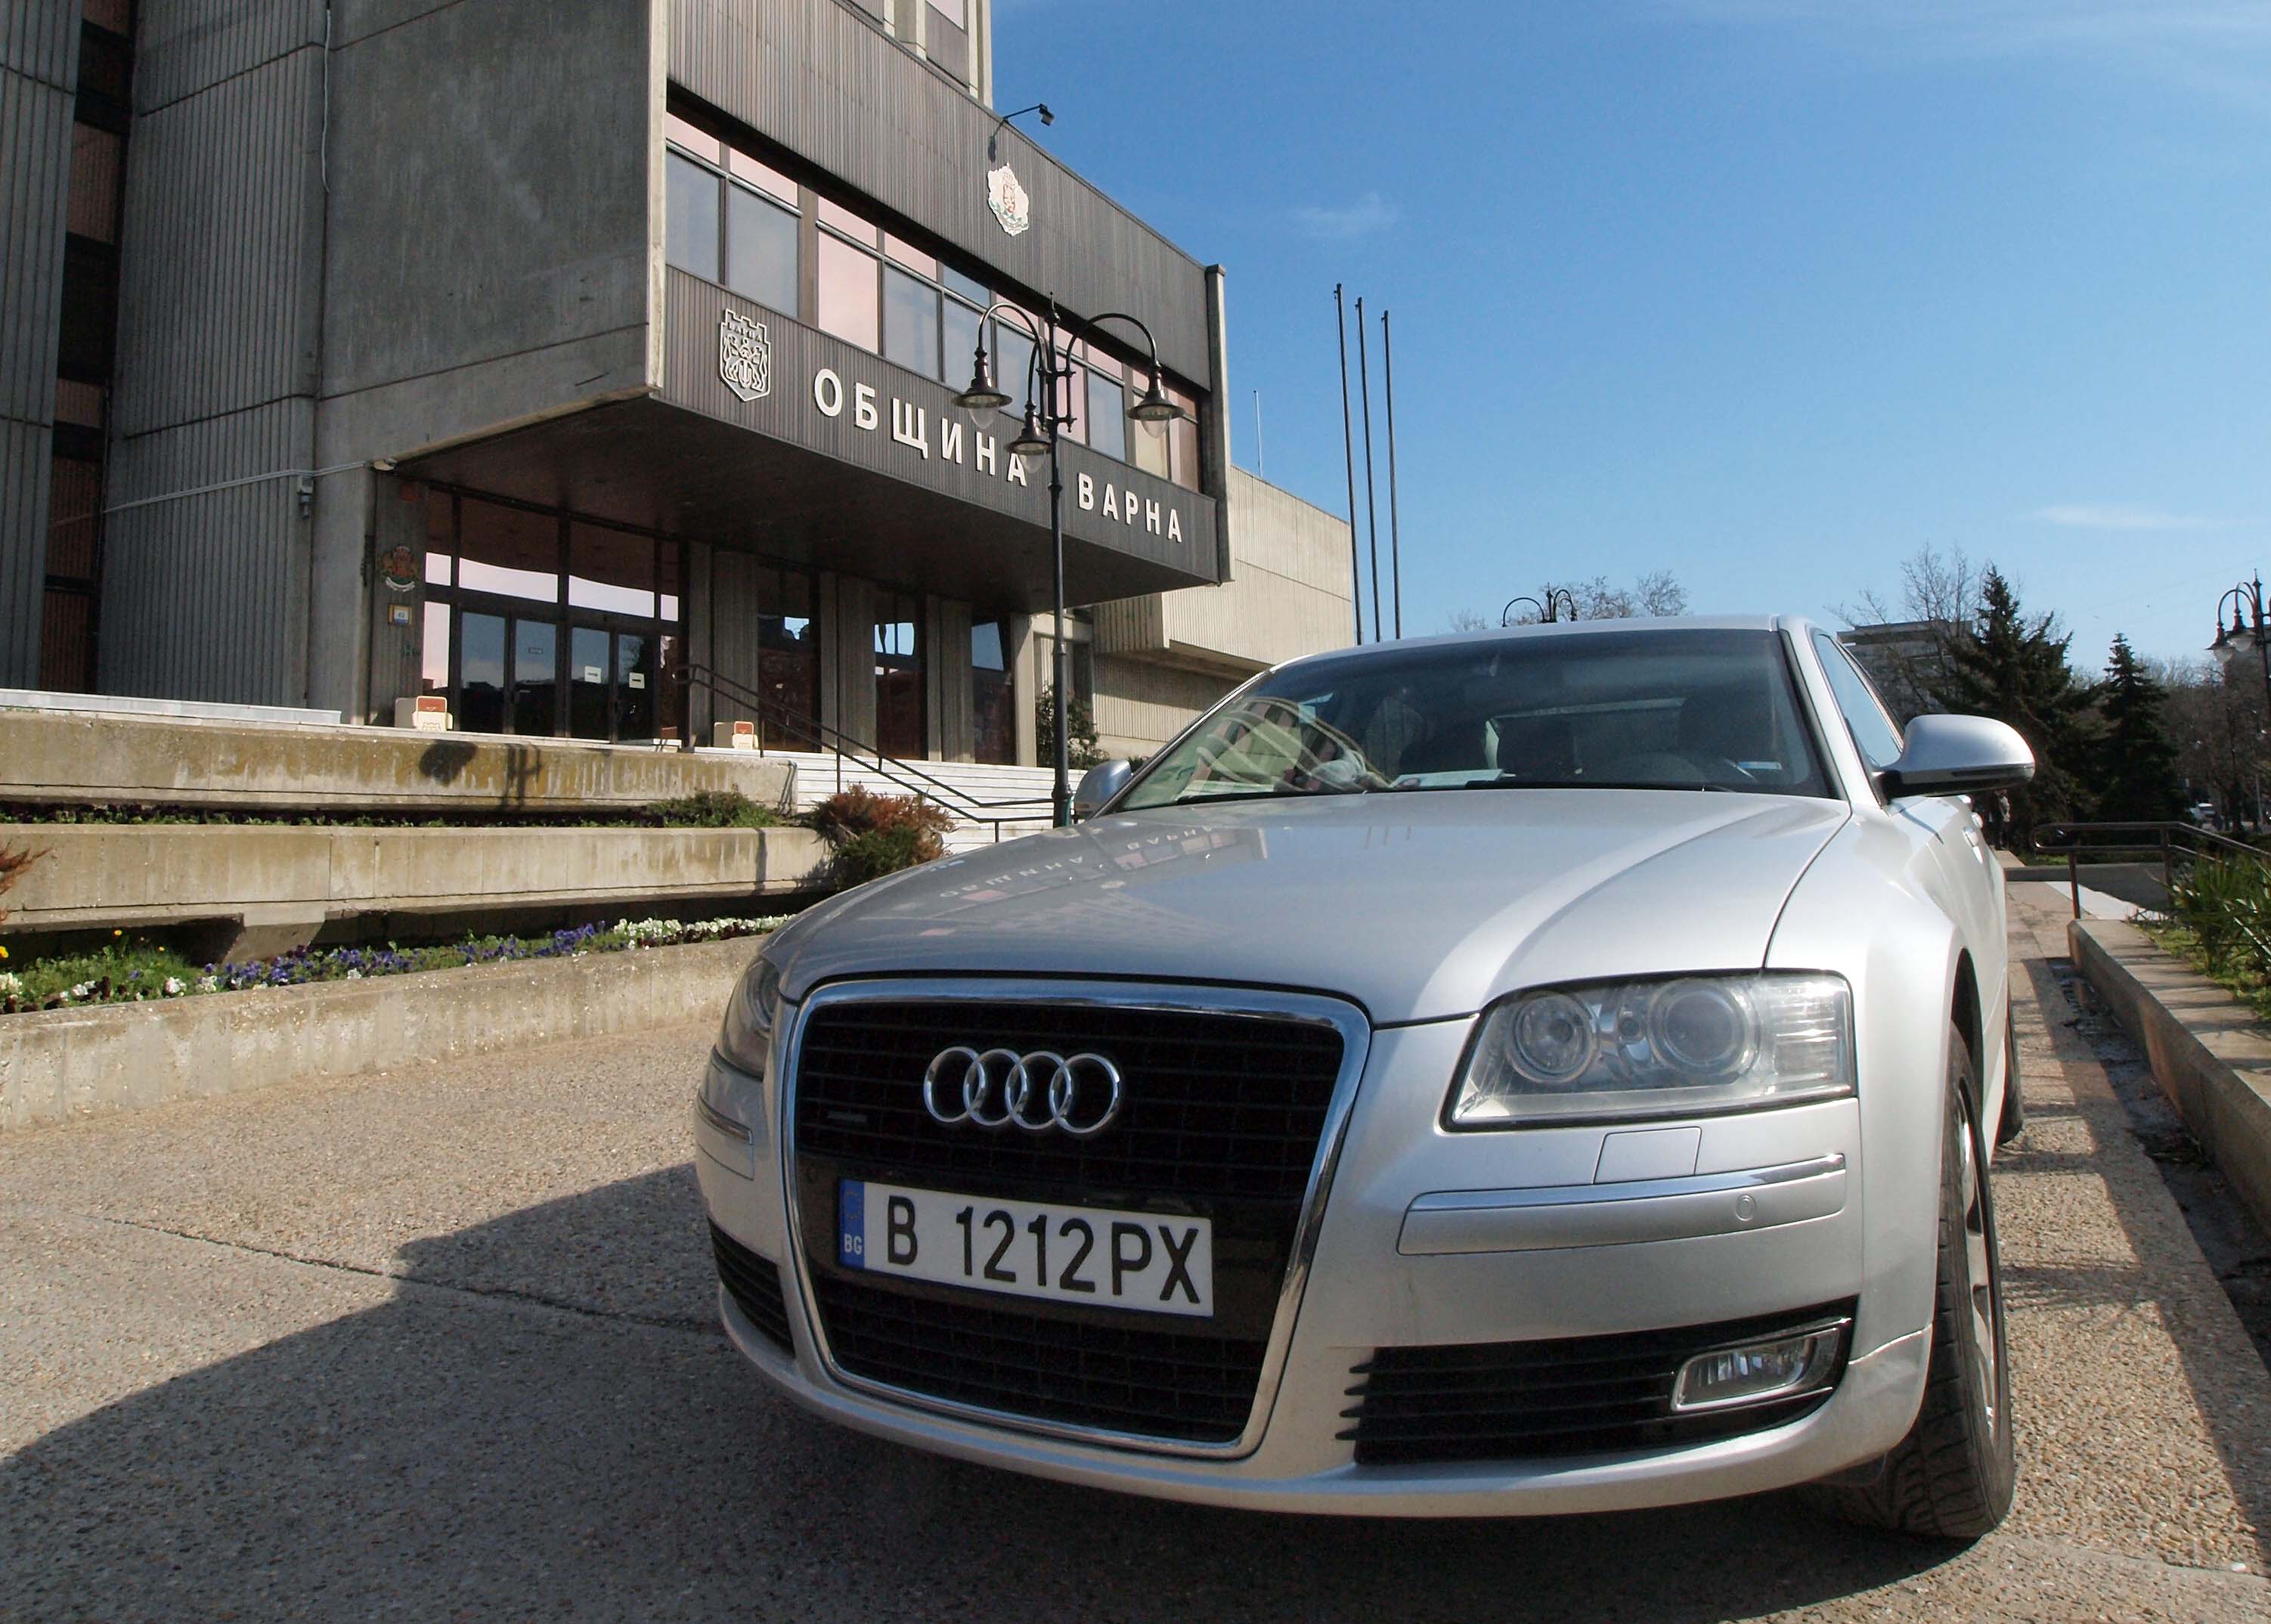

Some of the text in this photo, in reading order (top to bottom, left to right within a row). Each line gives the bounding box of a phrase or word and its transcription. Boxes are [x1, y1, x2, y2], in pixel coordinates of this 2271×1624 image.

[814, 368, 1182, 543] ОБЩИНА ВАРНА
[844, 1233, 863, 1255] BG
